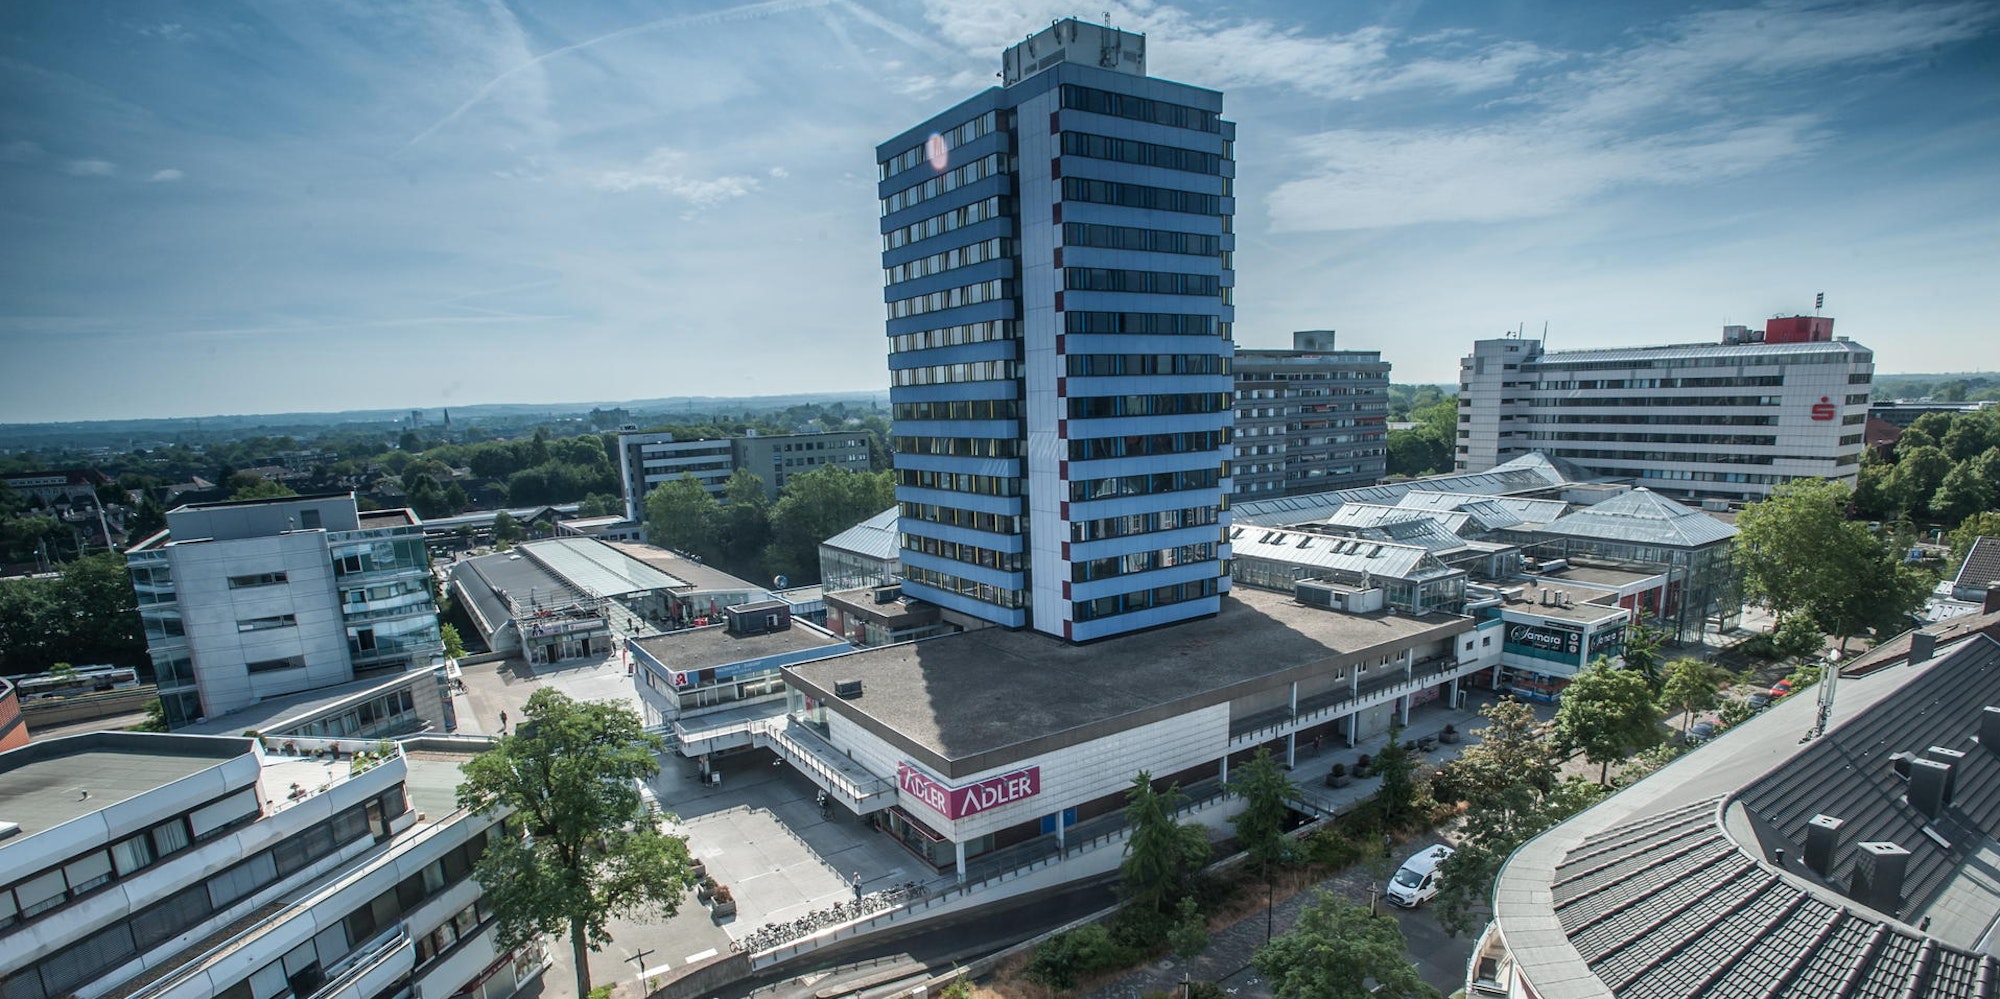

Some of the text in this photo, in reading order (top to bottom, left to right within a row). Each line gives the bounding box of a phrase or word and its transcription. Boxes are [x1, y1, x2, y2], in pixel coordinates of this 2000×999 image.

[1511, 625, 1561, 645] Samara
[904, 769, 947, 814] ADLER
[960, 777, 1032, 815] ADLER
